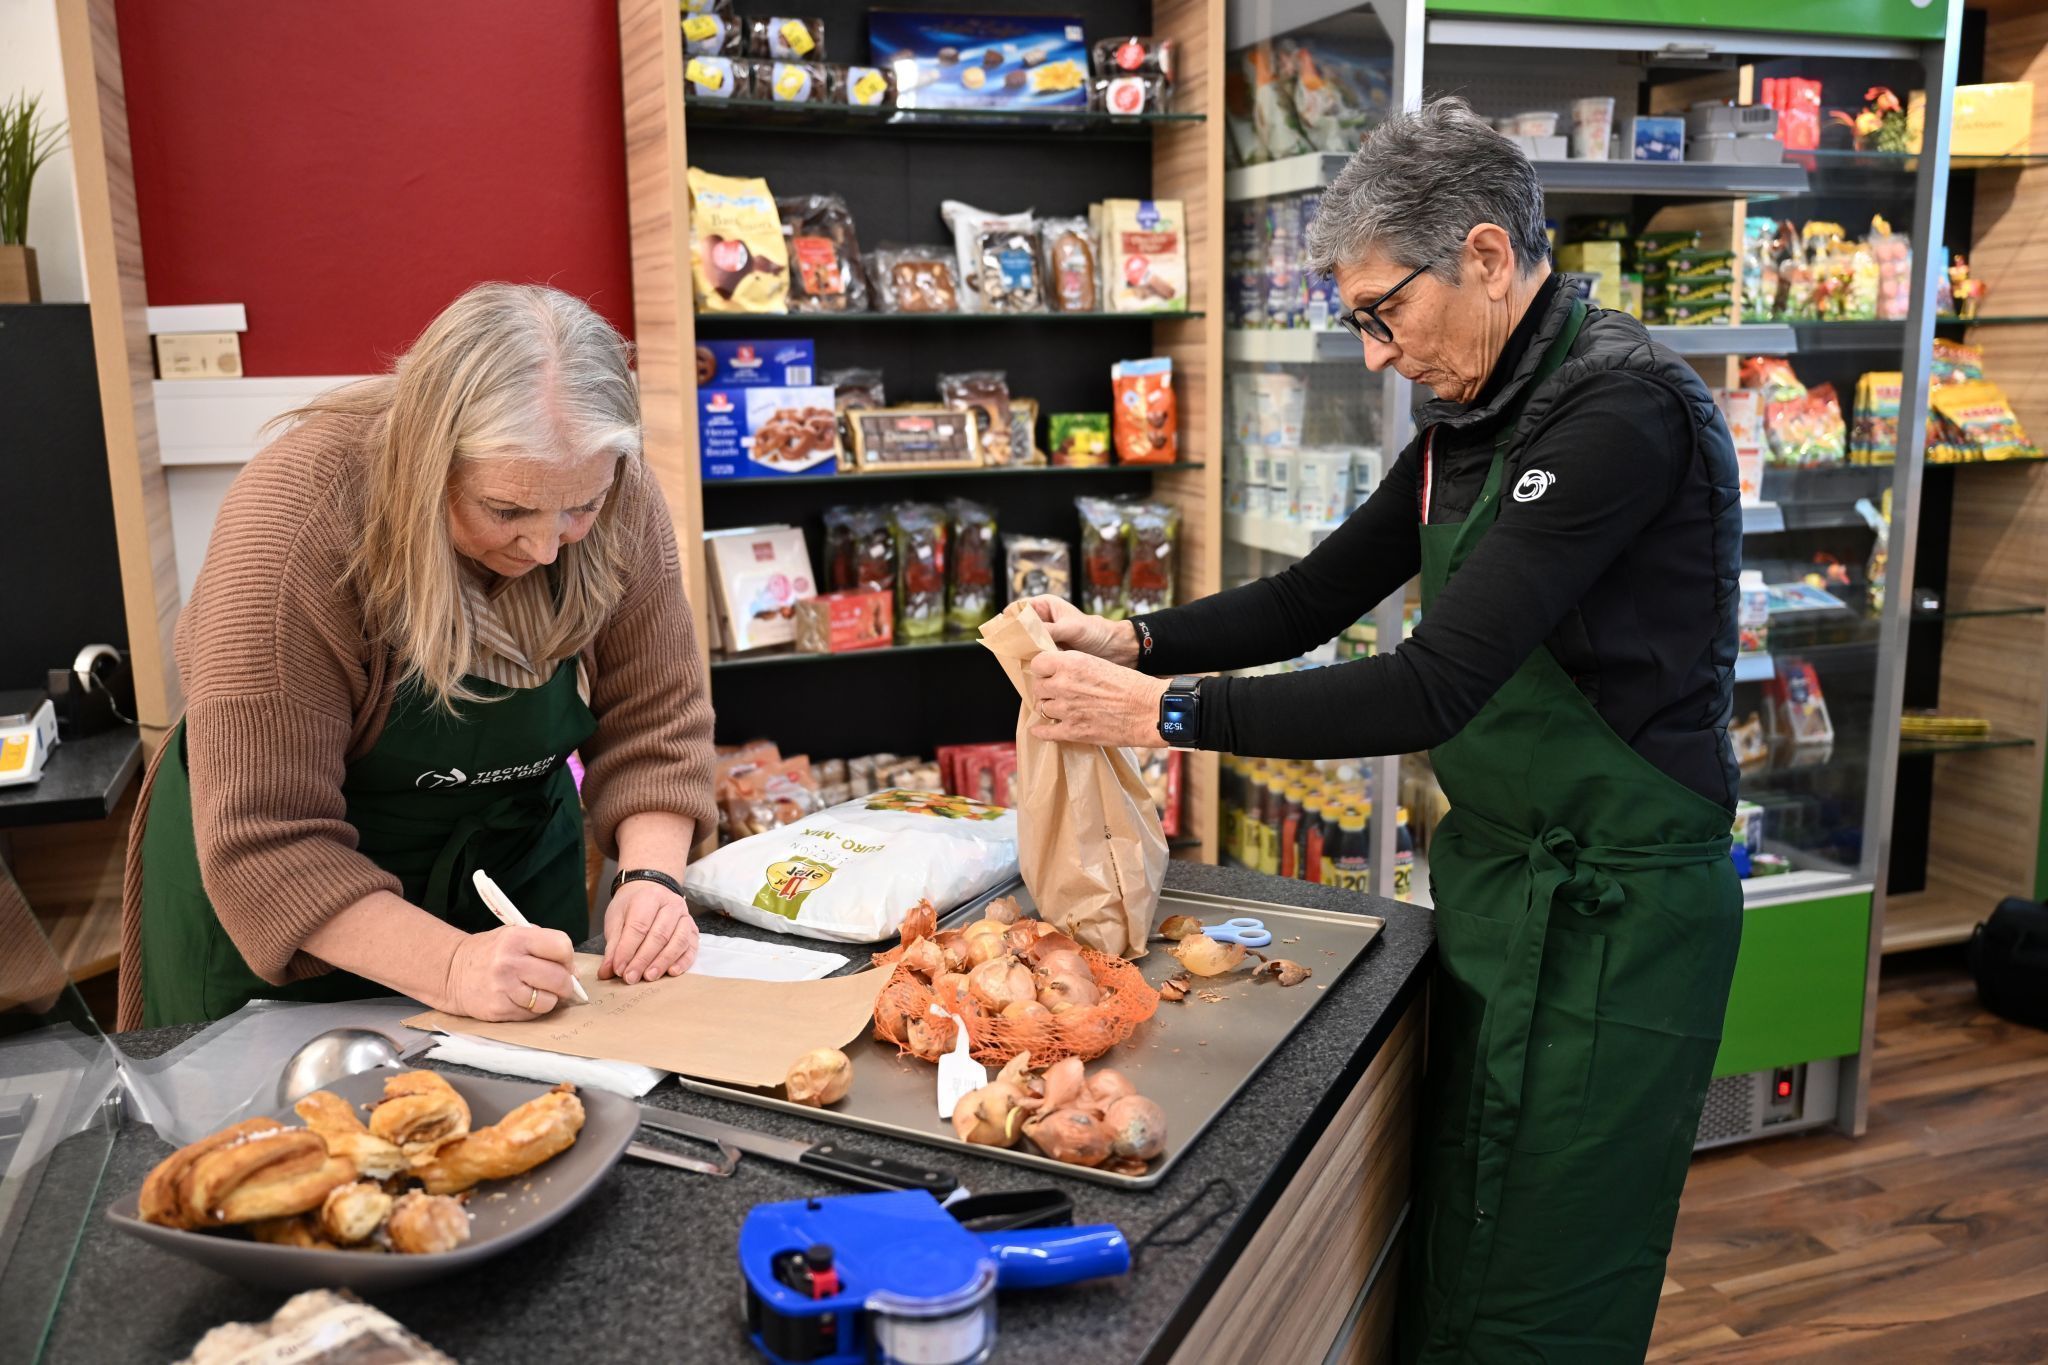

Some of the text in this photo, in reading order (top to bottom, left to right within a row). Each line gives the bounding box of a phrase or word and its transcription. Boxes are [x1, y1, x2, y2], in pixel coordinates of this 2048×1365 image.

[1164, 722, 1183, 731] 15:28
[470, 774, 514, 785] DECK
[517, 763, 551, 777] DICH
[477, 754, 556, 779] TISCHLEIN
